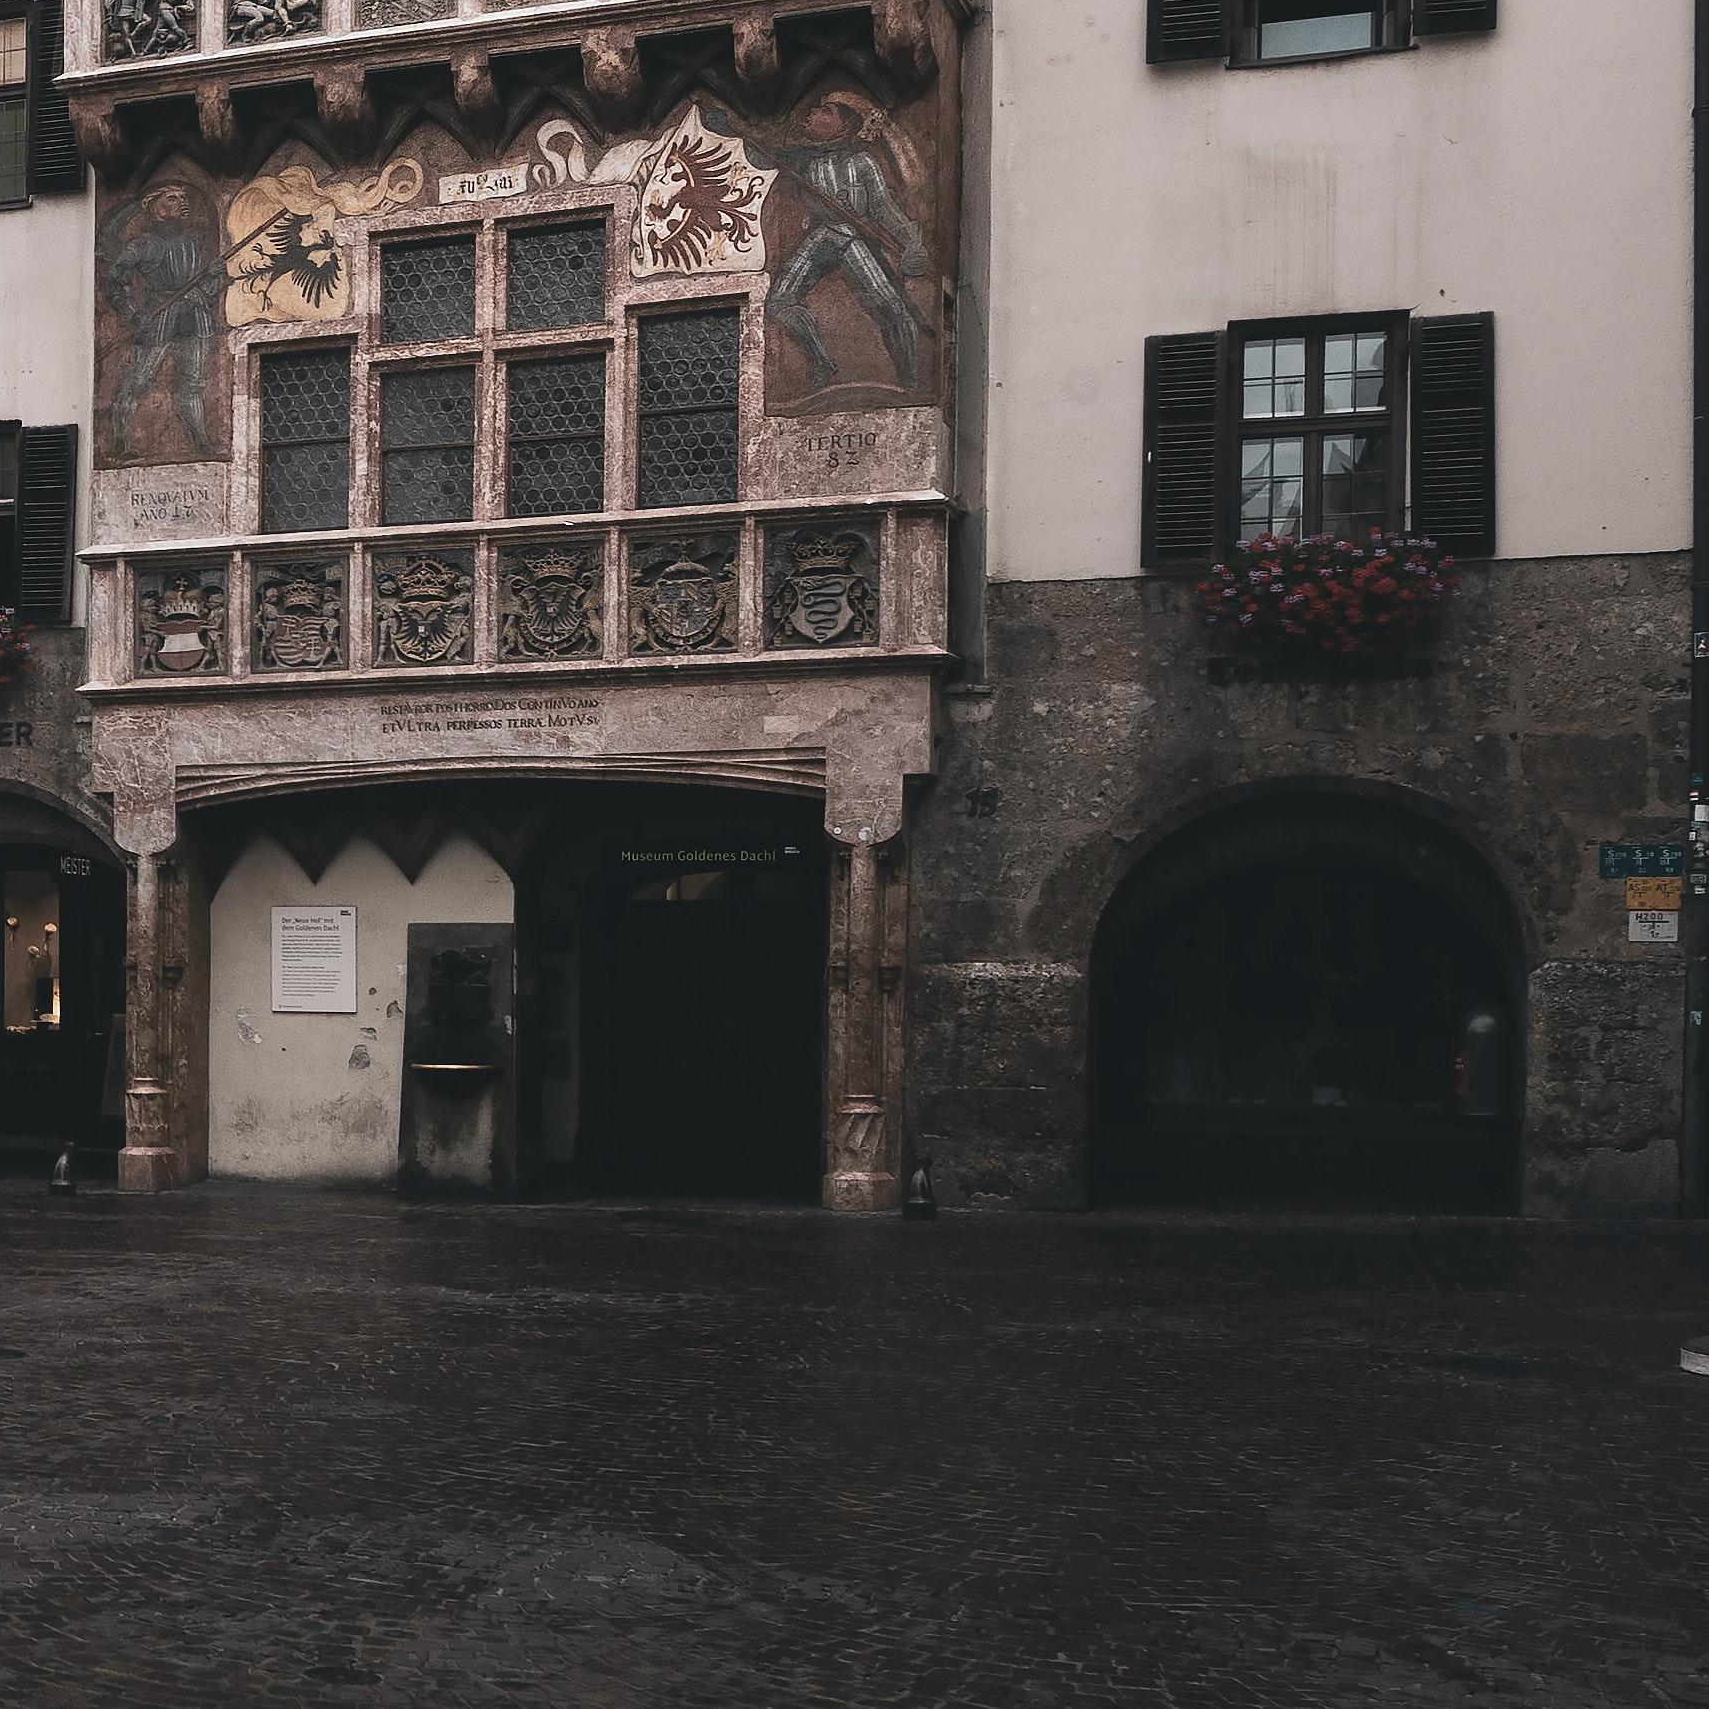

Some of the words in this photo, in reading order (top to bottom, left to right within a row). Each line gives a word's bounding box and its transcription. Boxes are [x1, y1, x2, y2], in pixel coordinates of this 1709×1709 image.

[804, 432, 877, 451] TERTIO
[621, 850, 673, 862] Museum
[678, 848, 736, 862] Goldenes
[740, 848, 776, 862] Dachl
[61, 856, 90, 876] MEISTER
